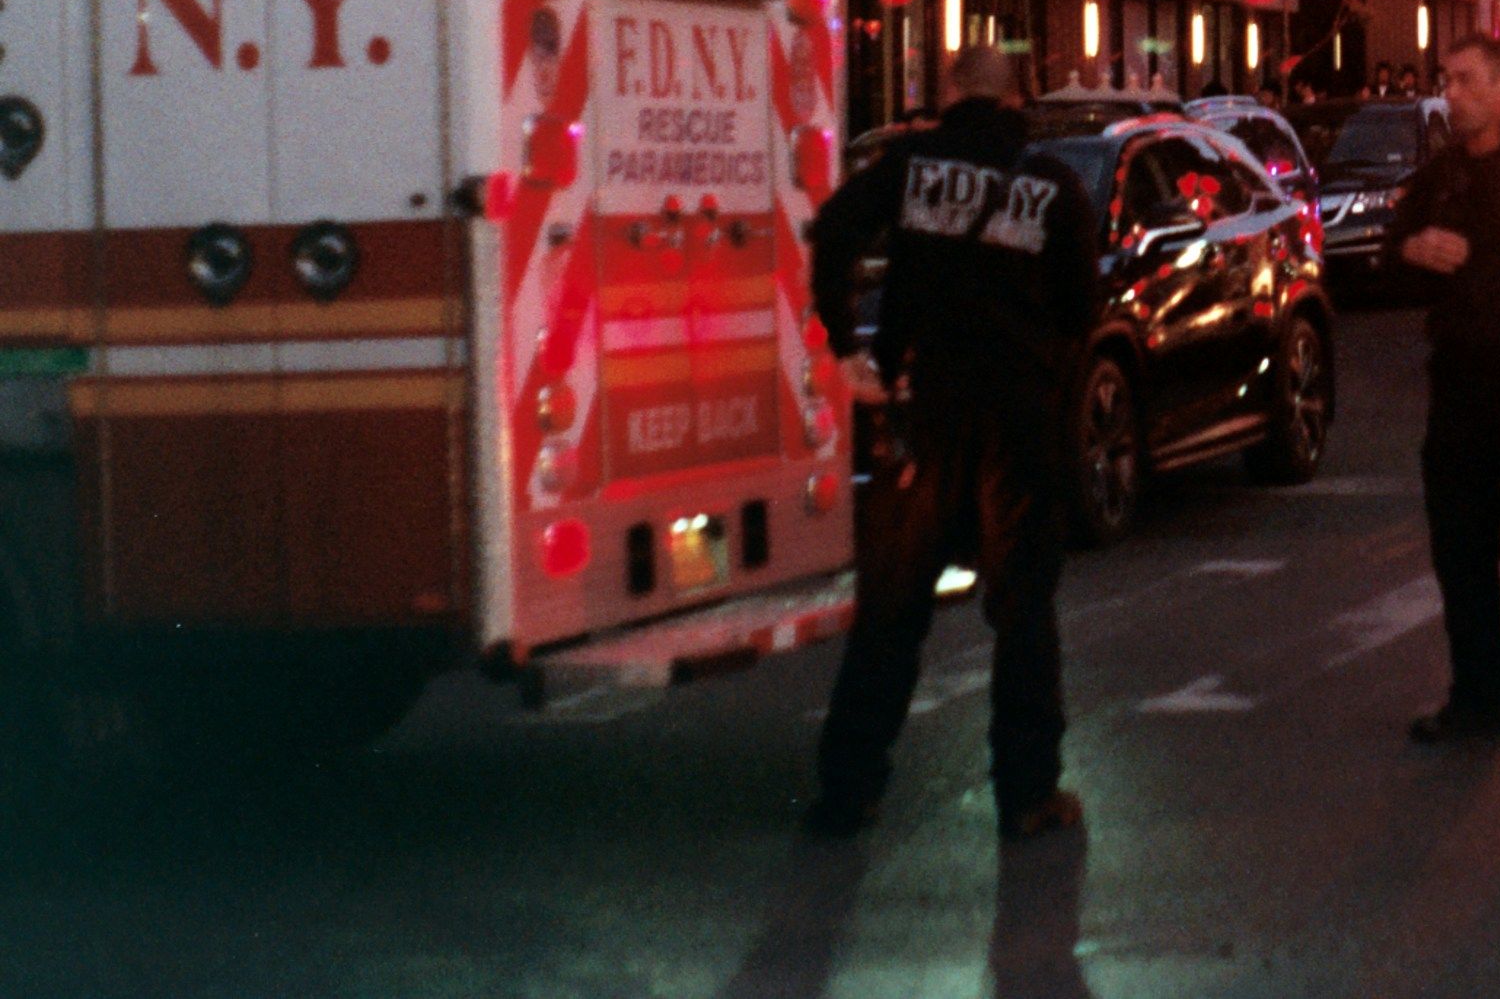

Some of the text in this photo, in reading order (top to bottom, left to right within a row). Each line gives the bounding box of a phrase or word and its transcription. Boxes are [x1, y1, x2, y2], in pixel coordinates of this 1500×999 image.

[613, 14, 757, 104] F.D.N.Y.
[638, 108, 737, 145] RESCUE
[607, 150, 765, 187] PARAMEDICS
[628, 394, 760, 454] KEEP BACK
